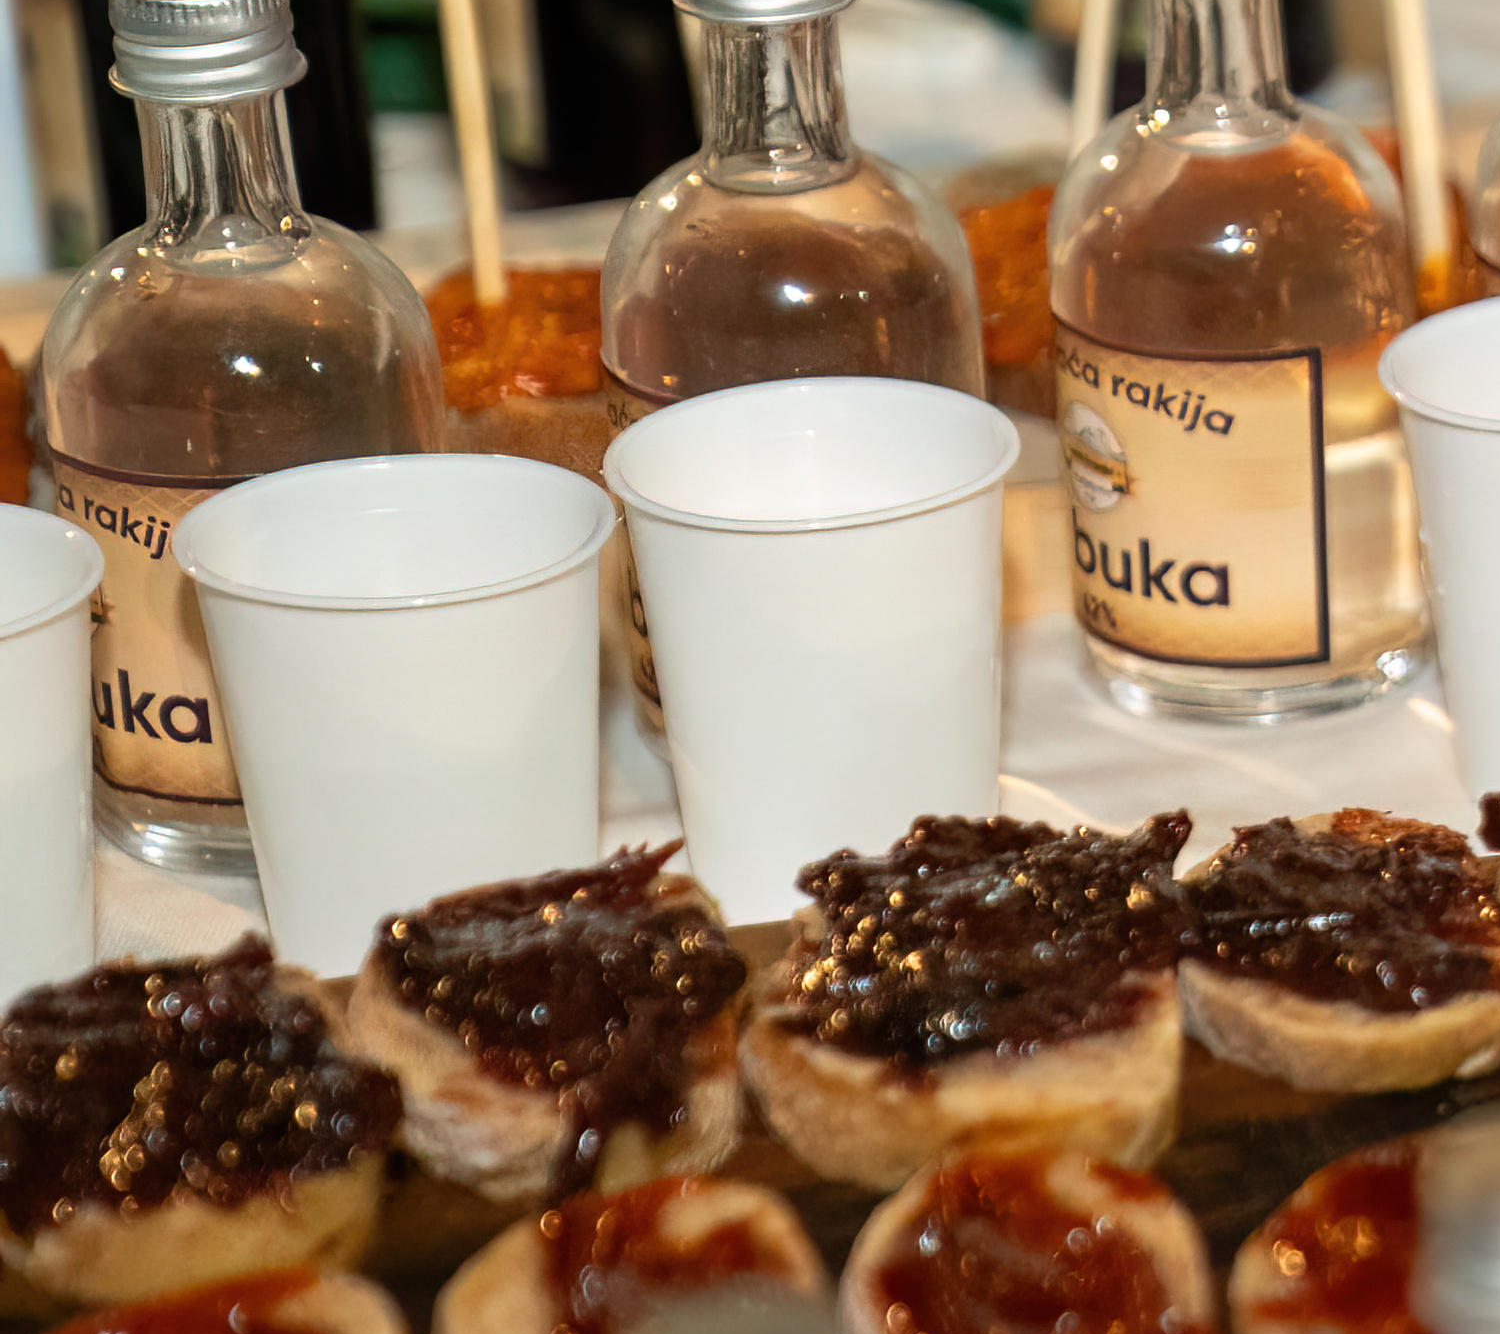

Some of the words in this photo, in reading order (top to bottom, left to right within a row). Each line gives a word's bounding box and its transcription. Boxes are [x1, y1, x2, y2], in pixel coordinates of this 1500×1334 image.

[1111, 374, 1234, 435] rakija
[83, 495, 171, 559] rakij
[1072, 505, 1230, 607] buka
